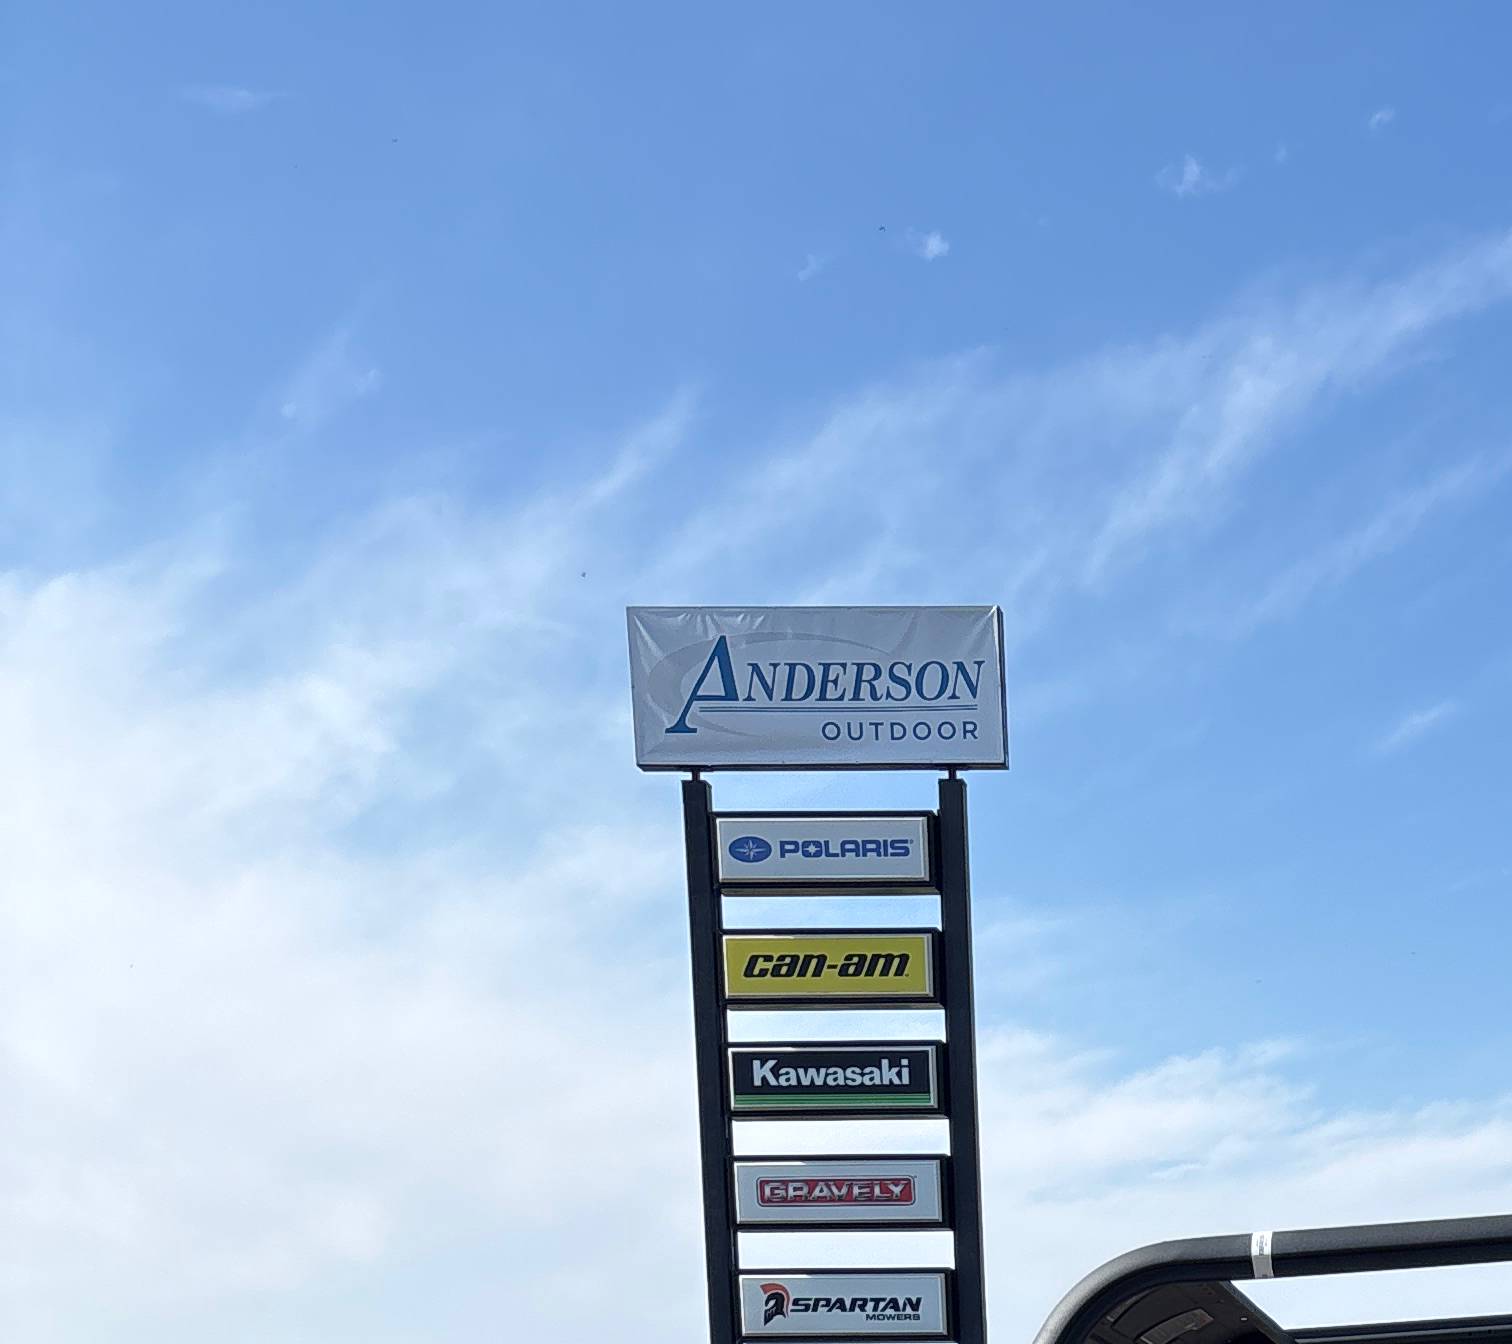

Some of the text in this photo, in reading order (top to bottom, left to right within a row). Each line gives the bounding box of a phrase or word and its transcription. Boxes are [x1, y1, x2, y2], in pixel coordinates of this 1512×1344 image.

[665, 635, 985, 734] ANDERSON
[821, 720, 979, 742] OUTDOOR
[779, 838, 910, 859] POLARIS
[742, 952, 910, 979] can-am
[752, 1058, 910, 1087] Kawasaki
[764, 1180, 910, 1202] GRAVELY
[789, 1297, 923, 1313] SPARTAN
[865, 1313, 921, 1321] MOWERS
